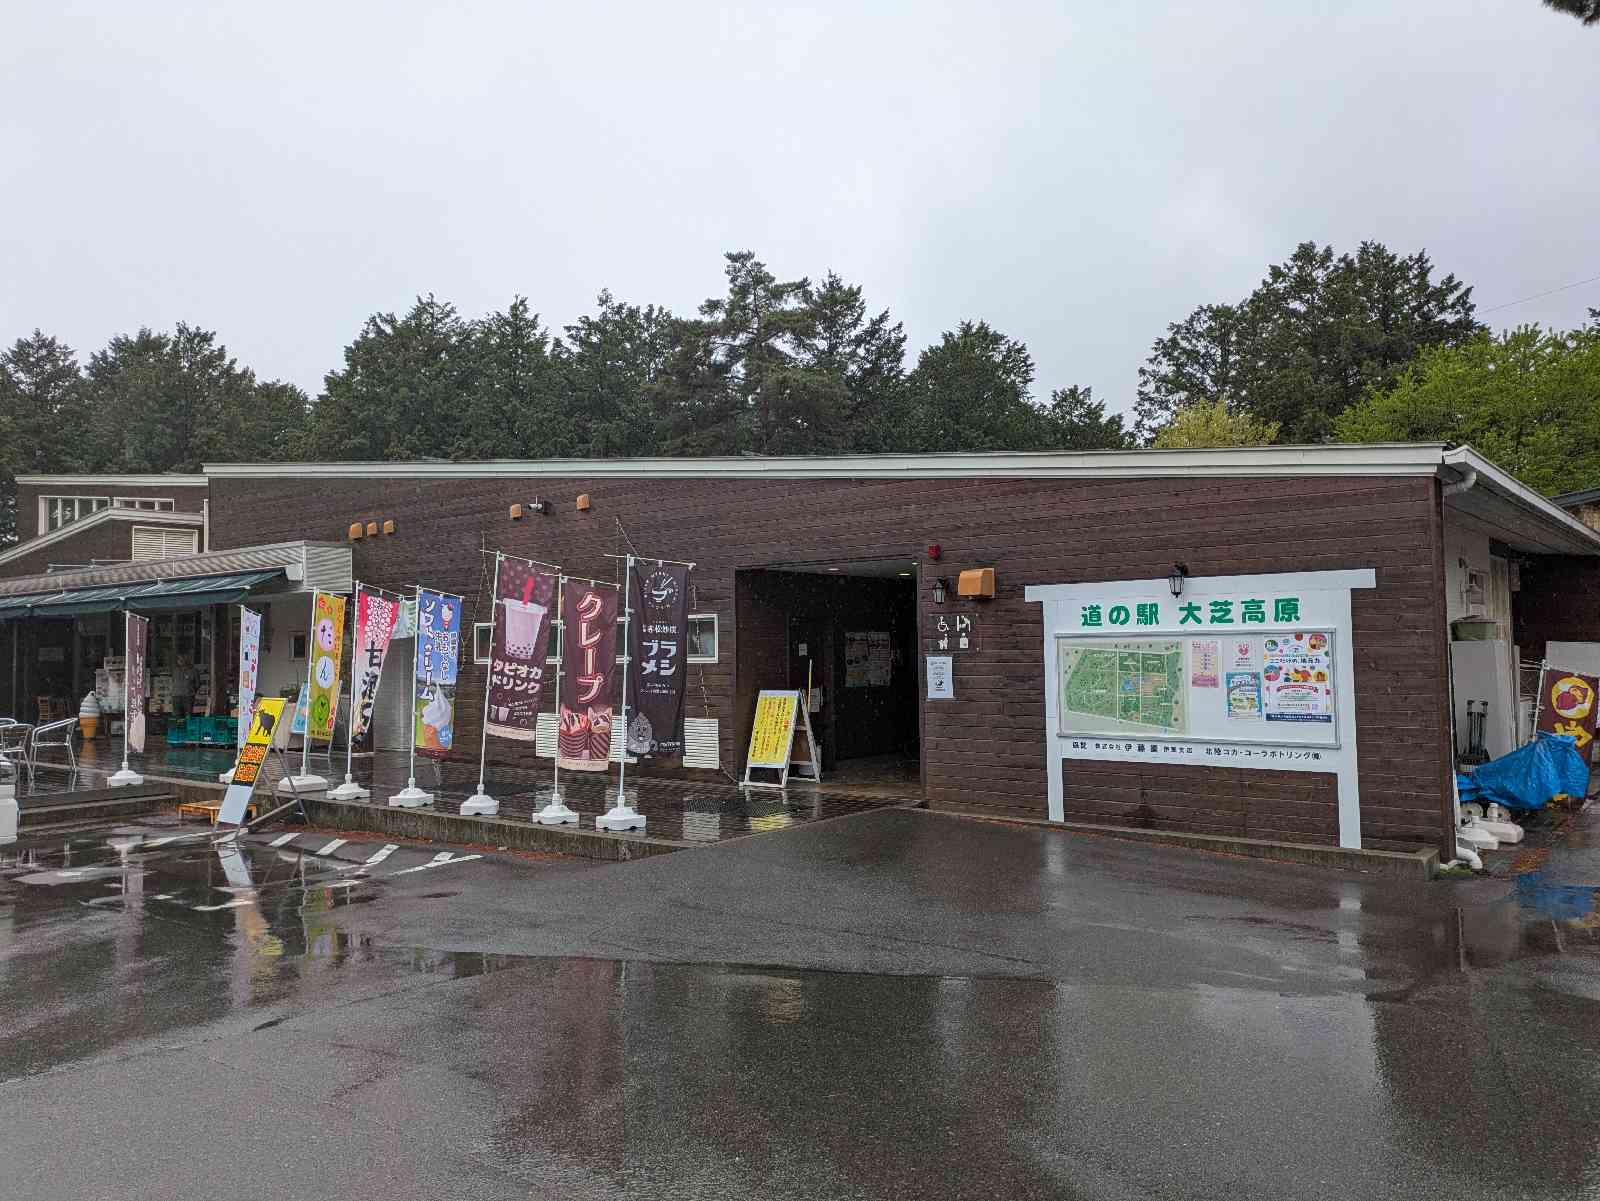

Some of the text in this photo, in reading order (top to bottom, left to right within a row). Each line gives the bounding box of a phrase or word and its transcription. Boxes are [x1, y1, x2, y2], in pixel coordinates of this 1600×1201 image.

[1081, 597, 1301, 627] 道の駅 大芝高原
[576, 591, 604, 704] クレープ
[641, 639, 678, 658] ブラ
[493, 658, 543, 680] タピオカ
[640, 659, 677, 676] メシ
[491, 674, 541, 694] ドリンク
